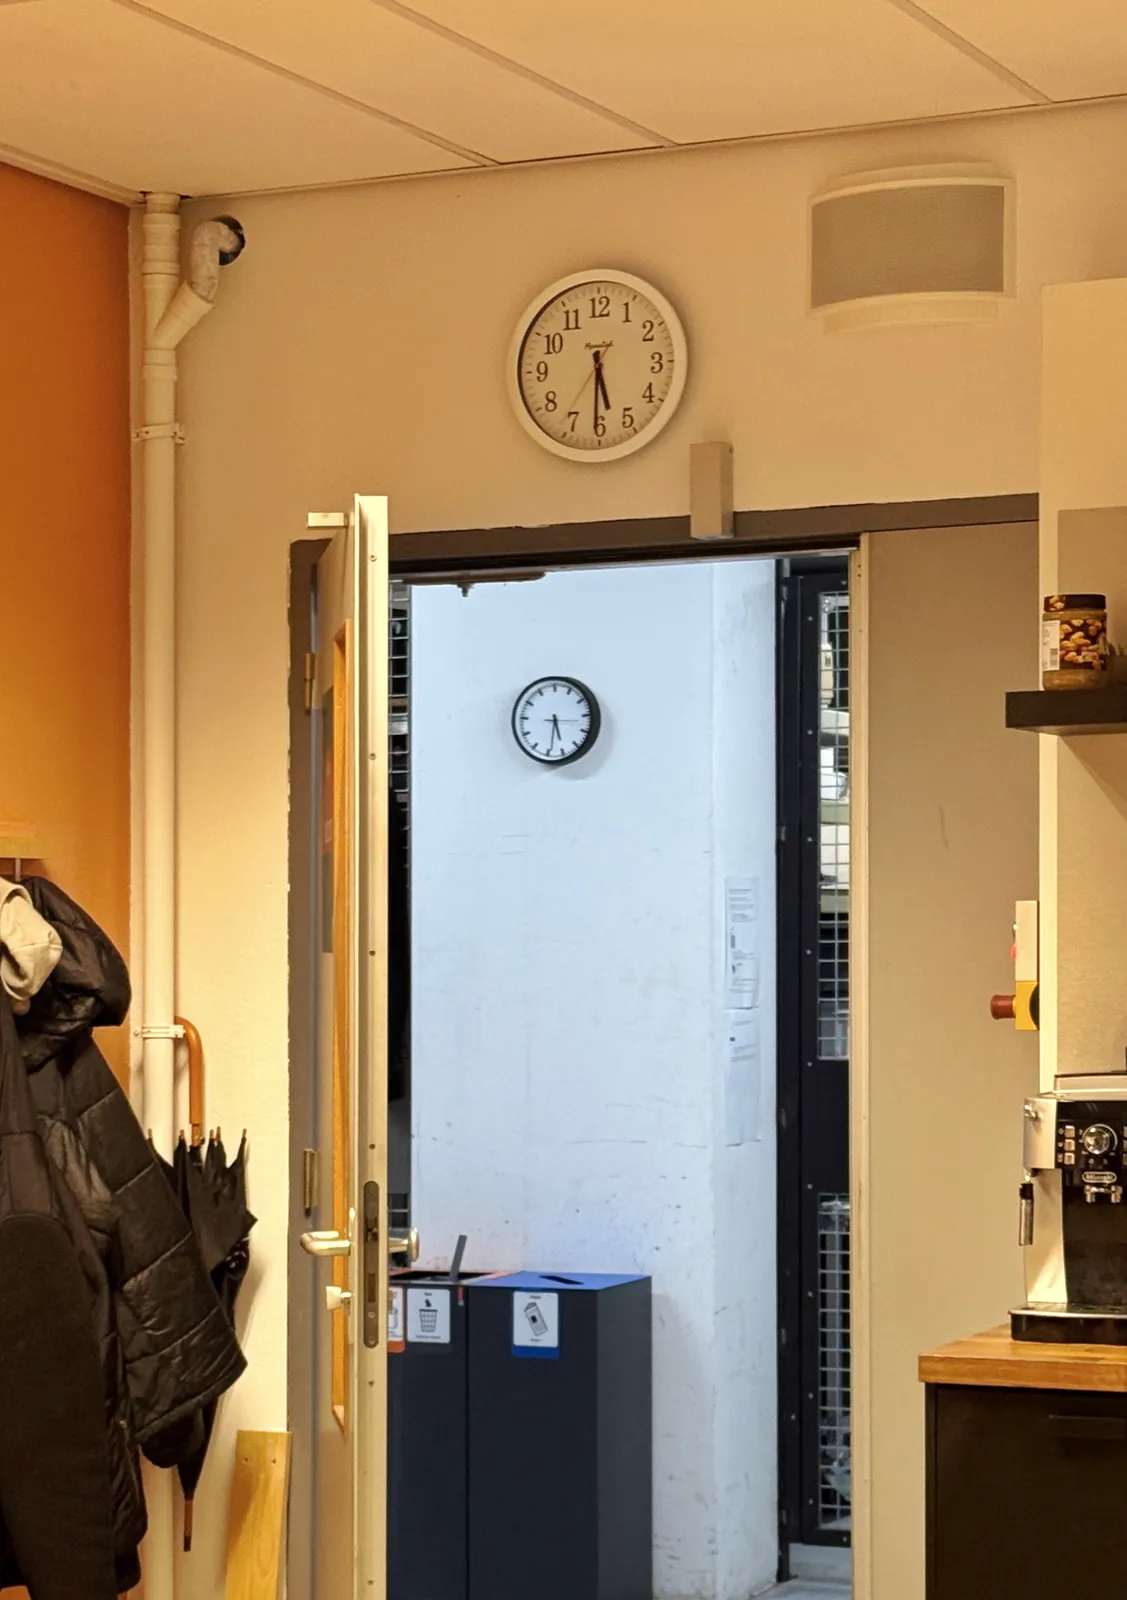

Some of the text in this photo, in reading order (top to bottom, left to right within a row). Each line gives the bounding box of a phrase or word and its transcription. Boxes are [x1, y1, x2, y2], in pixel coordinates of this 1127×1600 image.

[589, 296, 610, 318] 12
[622, 302, 632, 323] 1
[563, 309, 581, 331] 11
[642, 320, 654, 342] 2
[544, 332, 563, 354] 10
[536, 361, 548, 382] 9
[651, 352, 663, 373] 3
[545, 391, 557, 412] 8
[642, 382, 655, 403] 4
[567, 411, 579, 432] 7
[594, 416, 606, 437] 6
[622, 407, 634, 428] 5
